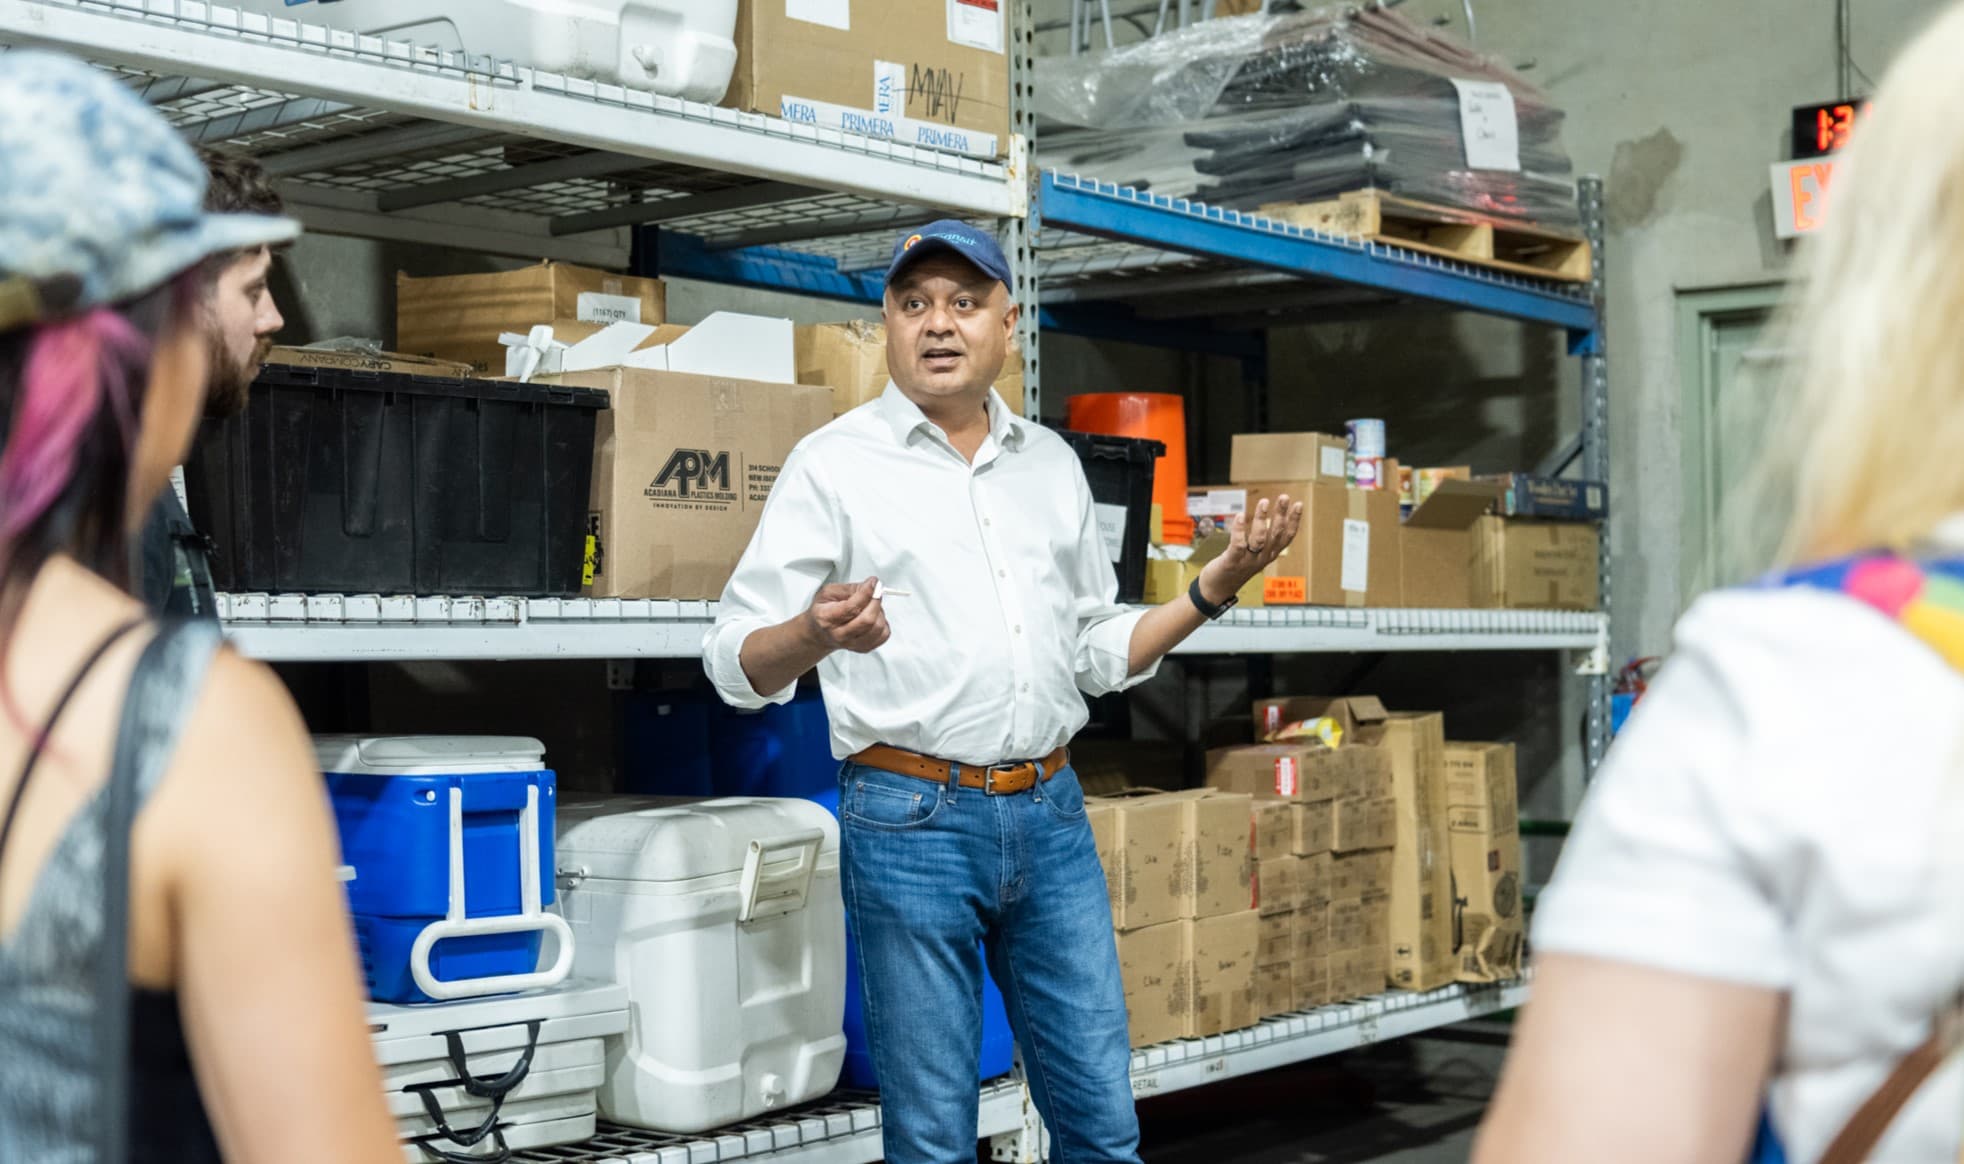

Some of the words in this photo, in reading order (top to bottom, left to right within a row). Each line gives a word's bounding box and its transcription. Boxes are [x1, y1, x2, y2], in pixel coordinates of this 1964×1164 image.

[781, 101, 817, 123] MERA
[841, 111, 895, 137] PRIMERA
[917, 126, 969, 152] PRIMERA
[650, 448, 731, 499] APM
[758, 465, 781, 473] SCHOO
[643, 488, 677, 498] ACADIANA
[690, 490, 714, 500] PLASTICS
[714, 492, 737, 501] MOLDING
[653, 502, 693, 510] INNOVATION
[695, 503, 703, 511] BY
[705, 504, 728, 512] DESIGN
